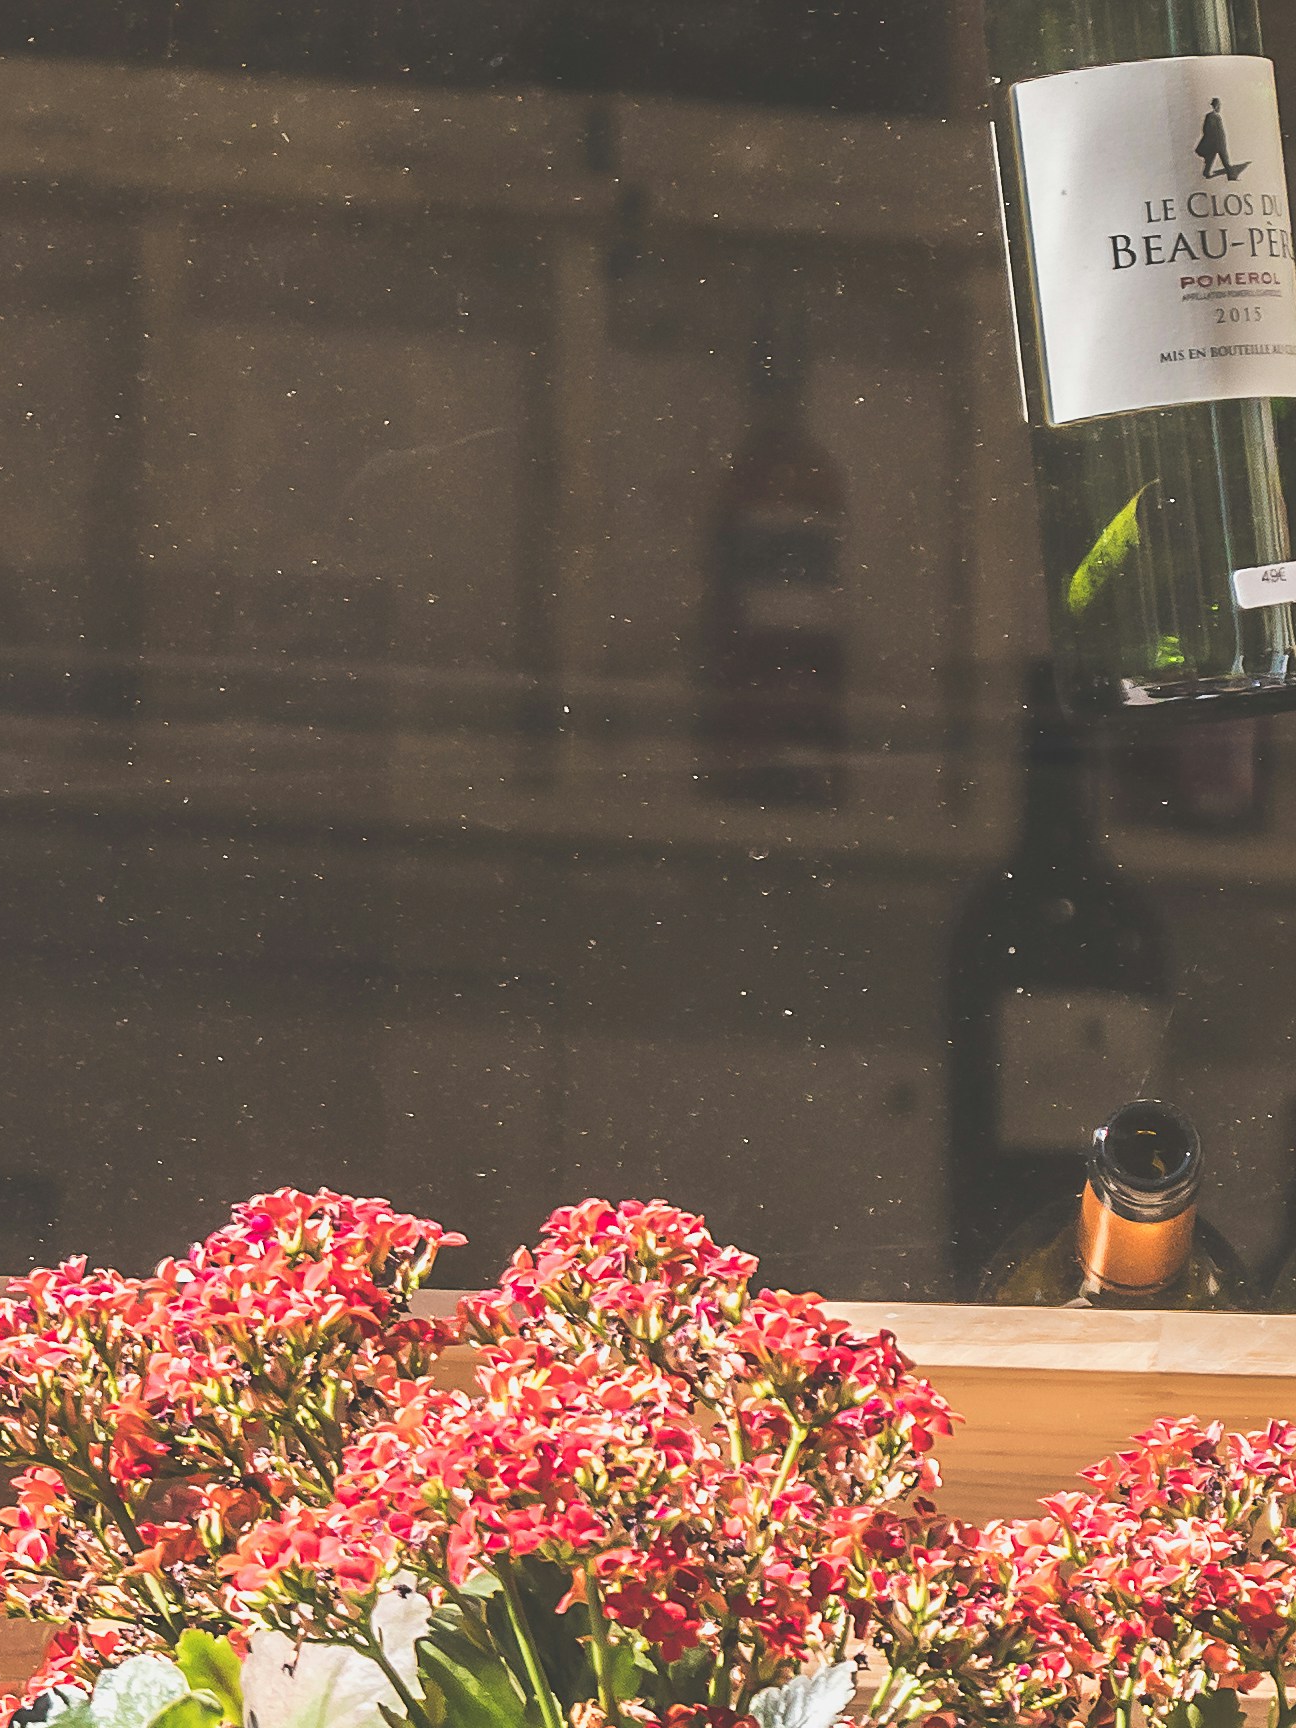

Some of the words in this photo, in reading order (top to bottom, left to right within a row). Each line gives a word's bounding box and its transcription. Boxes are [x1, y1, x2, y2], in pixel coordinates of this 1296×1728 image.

[1145, 198, 1177, 224] LE
[1187, 192, 1254, 218] CLOS
[1108, 221, 1296, 271] BEAU-PÈR
[1180, 271, 1281, 290] POMEROL
[1215, 306, 1262, 324] 2015
[1160, 350, 1184, 363] MIS
[1189, 347, 1206, 359] EN
